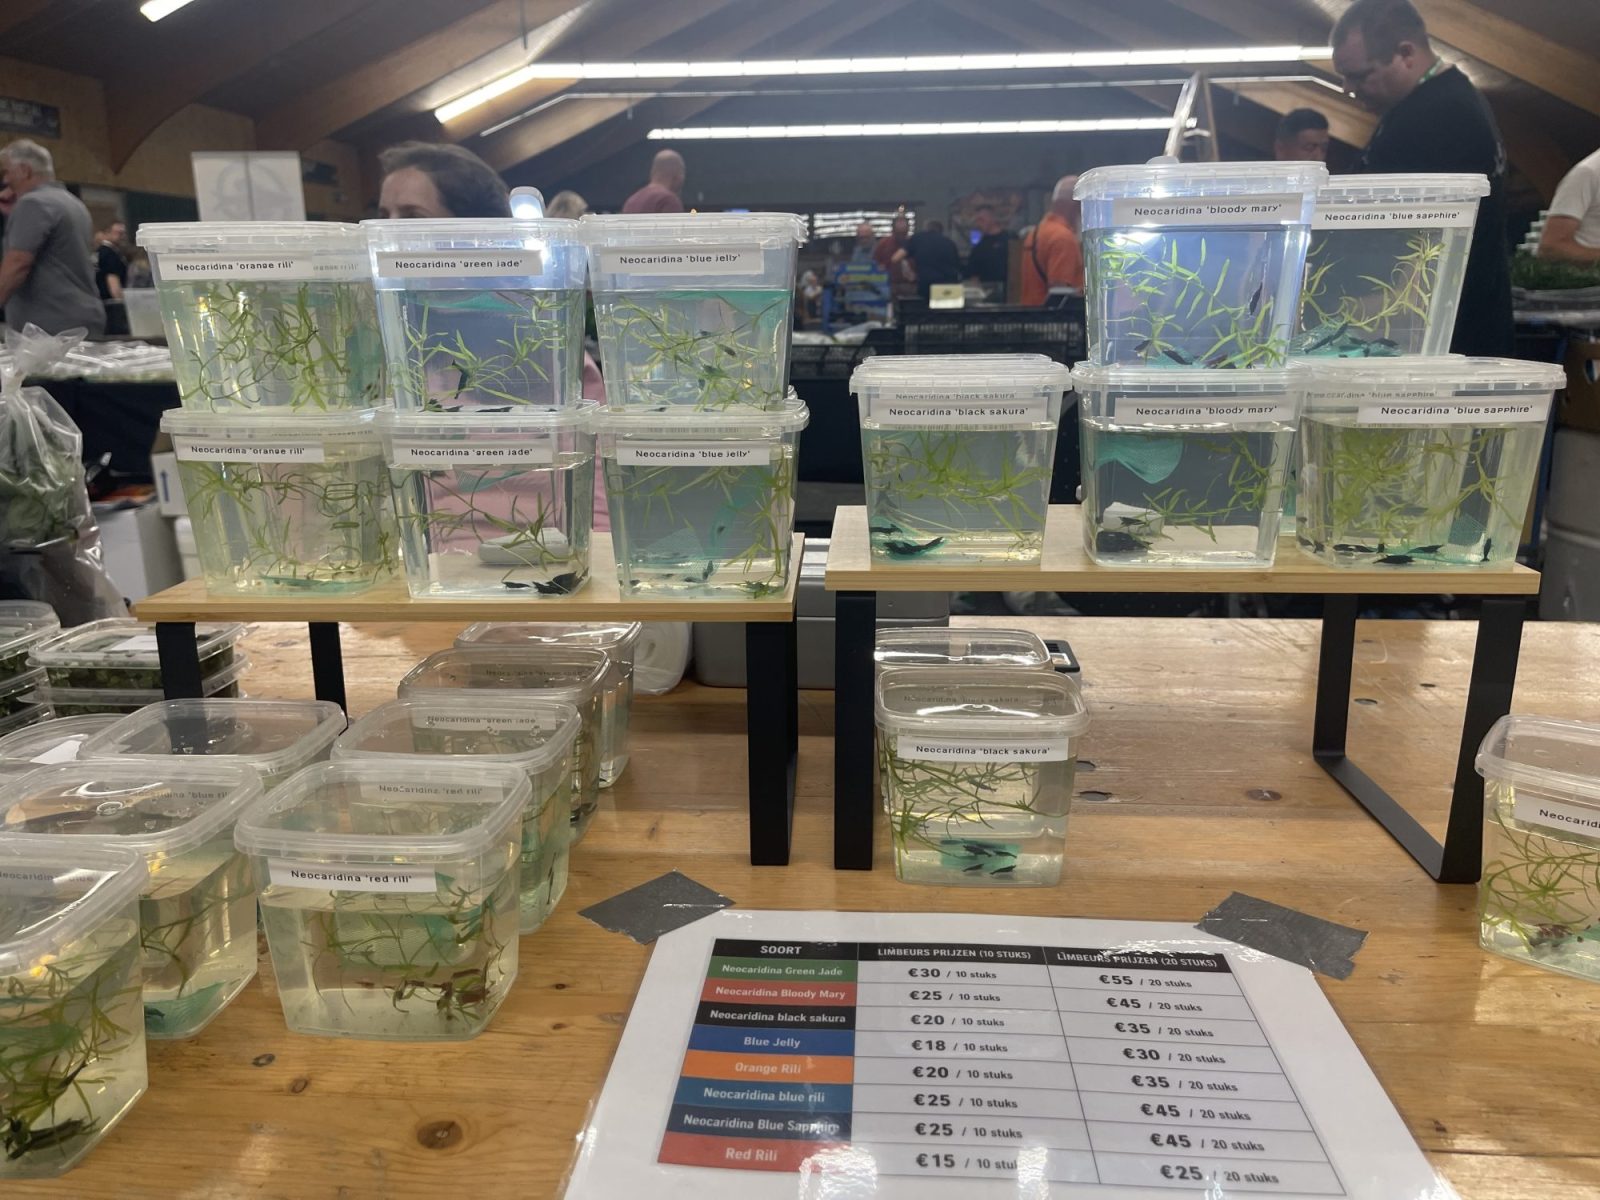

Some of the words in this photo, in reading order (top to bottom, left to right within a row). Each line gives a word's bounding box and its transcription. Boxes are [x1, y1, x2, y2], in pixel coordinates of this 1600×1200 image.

[1134, 207, 1202, 216] Neocaridina
[1206, 205, 1246, 214] 'bloody
[1251, 204, 1282, 213] mary'
[1325, 212, 1386, 221] Neocaridina
[1389, 212, 1413, 220] 'blue
[1416, 211, 1460, 220] sapphire'
[395, 260, 456, 269] Neocaridina
[459, 260, 493, 269] 'green
[496, 259, 523, 268] jade'
[620, 255, 683, 264] Neocaridina
[686, 254, 712, 263] 'blue
[715, 253, 741, 263] jelly'
[176, 263, 233, 271] Neocaridina
[236, 261, 274, 270] 'orange
[889, 407, 952, 416] Neocaridina
[955, 407, 986, 416] 'black
[989, 407, 1028, 415] sakura'
[1136, 407, 1201, 415] Neocaridina
[1205, 407, 1244, 415] 'bloody
[1248, 405, 1278, 414] mary'
[1381, 406, 1450, 415] Neocaridina
[1453, 406, 1480, 414] 'blue
[1484, 405, 1533, 414] sapphire'
[191, 445, 247, 454] Neocaridina
[249, 447, 286, 455] 'orange
[411, 448, 469, 456] Neocaridina
[472, 448, 504, 456] 'green
[507, 448, 533, 456] jade'
[635, 449, 695, 458] Neocaridina
[698, 450, 723, 458] 'blue
[726, 450, 751, 458] jelly'
[916, 745, 976, 755] Neocaridina
[979, 746, 1010, 755] 'black
[1013, 747, 1050, 755] sakura'
[378, 784, 440, 794] Neocaridina
[291, 869, 361, 882] Neocaridina
[365, 874, 389, 883] 'red
[393, 874, 412, 884] rili'
[760, 945, 802, 955] SOORT
[878, 948, 930, 957] LIMBEURS
[933, 949, 977, 957] PRIJZEN
[979, 950, 994, 959] (10
[996, 951, 1032, 960] STUKS)
[1057, 952, 1111, 963] LIMBEURS
[1113, 954, 1158, 965] PRIJZEN
[1160, 957, 1178, 967] (20
[1180, 958, 1217, 968] STUKS)
[722, 964, 782, 975] Neocaridina
[785, 966, 815, 976] Green
[818, 967, 843, 976] Jade
[908, 968, 941, 978] €30
[946, 970, 951, 978] /
[956, 970, 967, 978] 10
[970, 971, 997, 979] stuks
[1099, 974, 1133, 986] €55
[1140, 978, 1144, 986] /
[1148, 978, 1162, 987] 20
[1164, 979, 1192, 988] stuks
[715, 986, 778, 997] Neocaridina
[780, 989, 817, 999] Bloody
[819, 989, 846, 1000] Mary
[909, 990, 943, 1001] €25
[949, 993, 953, 1001] /
[958, 993, 970, 1001] 10
[973, 993, 1001, 1002] stuks
[1106, 997, 1142, 1009] €45
[1149, 1001, 1152, 1010] /
[1157, 1002, 1171, 1011] 20
[1174, 1003, 1203, 1012] stuks
[709, 1009, 775, 1021] Neocaridina
[777, 1011, 807, 1022] black
[809, 1012, 846, 1023] sakura
[910, 1014, 945, 1025] €20
[951, 1017, 956, 1025] /
[961, 1017, 973, 1025] 10
[977, 1018, 1005, 1027] stuks
[1114, 1022, 1151, 1034] €35
[1158, 1026, 1162, 1035] /
[1167, 1027, 1181, 1036] 20
[1185, 1028, 1214, 1037] stuks
[743, 1036, 770, 1047] Blue
[772, 1037, 801, 1049] Jelly
[911, 1039, 946, 1051] €18
[953, 1042, 958, 1051] /
[964, 1043, 976, 1051] 10
[979, 1043, 1008, 1052] stuks
[1122, 1048, 1160, 1061] €30
[1168, 1052, 1172, 1061] /
[1177, 1053, 1192, 1062] 20
[1195, 1054, 1226, 1064] stuks
[735, 1062, 777, 1075] Orange
[781, 1063, 801, 1073] Rili
[912, 1066, 949, 1078] €20
[956, 1069, 961, 1079] /
[967, 1069, 980, 1079] 10
[983, 1070, 1013, 1080] stuks
[1131, 1074, 1170, 1088] €35
[1178, 1079, 1182, 1089] /
[1188, 1080, 1203, 1090] 20
[1206, 1081, 1239, 1092] stuks
[703, 1087, 775, 1101] Neocaridina
[778, 1091, 805, 1102] blue
[808, 1092, 825, 1103] rili
[913, 1093, 951, 1107] €25
[958, 1097, 964, 1107] /
[970, 1098, 983, 1107] 10
[986, 1098, 1018, 1109] stuks
[1140, 1103, 1181, 1117] €45
[1189, 1108, 1193, 1118] /
[1199, 1109, 1215, 1119] 20
[1218, 1110, 1252, 1121] stuks
[683, 1114, 754, 1129] Neocaridina
[757, 1118, 784, 1131] Blue
[914, 1122, 953, 1137] €25
[961, 1127, 967, 1137] /
[974, 1127, 987, 1137] 10
[990, 1128, 1023, 1139] stuks
[1150, 1133, 1192, 1149] €45
[1200, 1138, 1205, 1149] /
[1211, 1139, 1227, 1150] 20
[1231, 1140, 1265, 1151] stuks
[725, 1147, 751, 1161] Red
[755, 1149, 777, 1162] Rili
[916, 1153, 956, 1169] €15
[964, 1157, 970, 1169] /
[976, 1158, 991, 1170] 10
[995, 1159, 1018, 1171] stu
[1160, 1164, 1203, 1181] €25
[1213, 1170, 1217, 1181] /
[1223, 1171, 1240, 1182] 20
[1244, 1172, 1280, 1184] stuks
